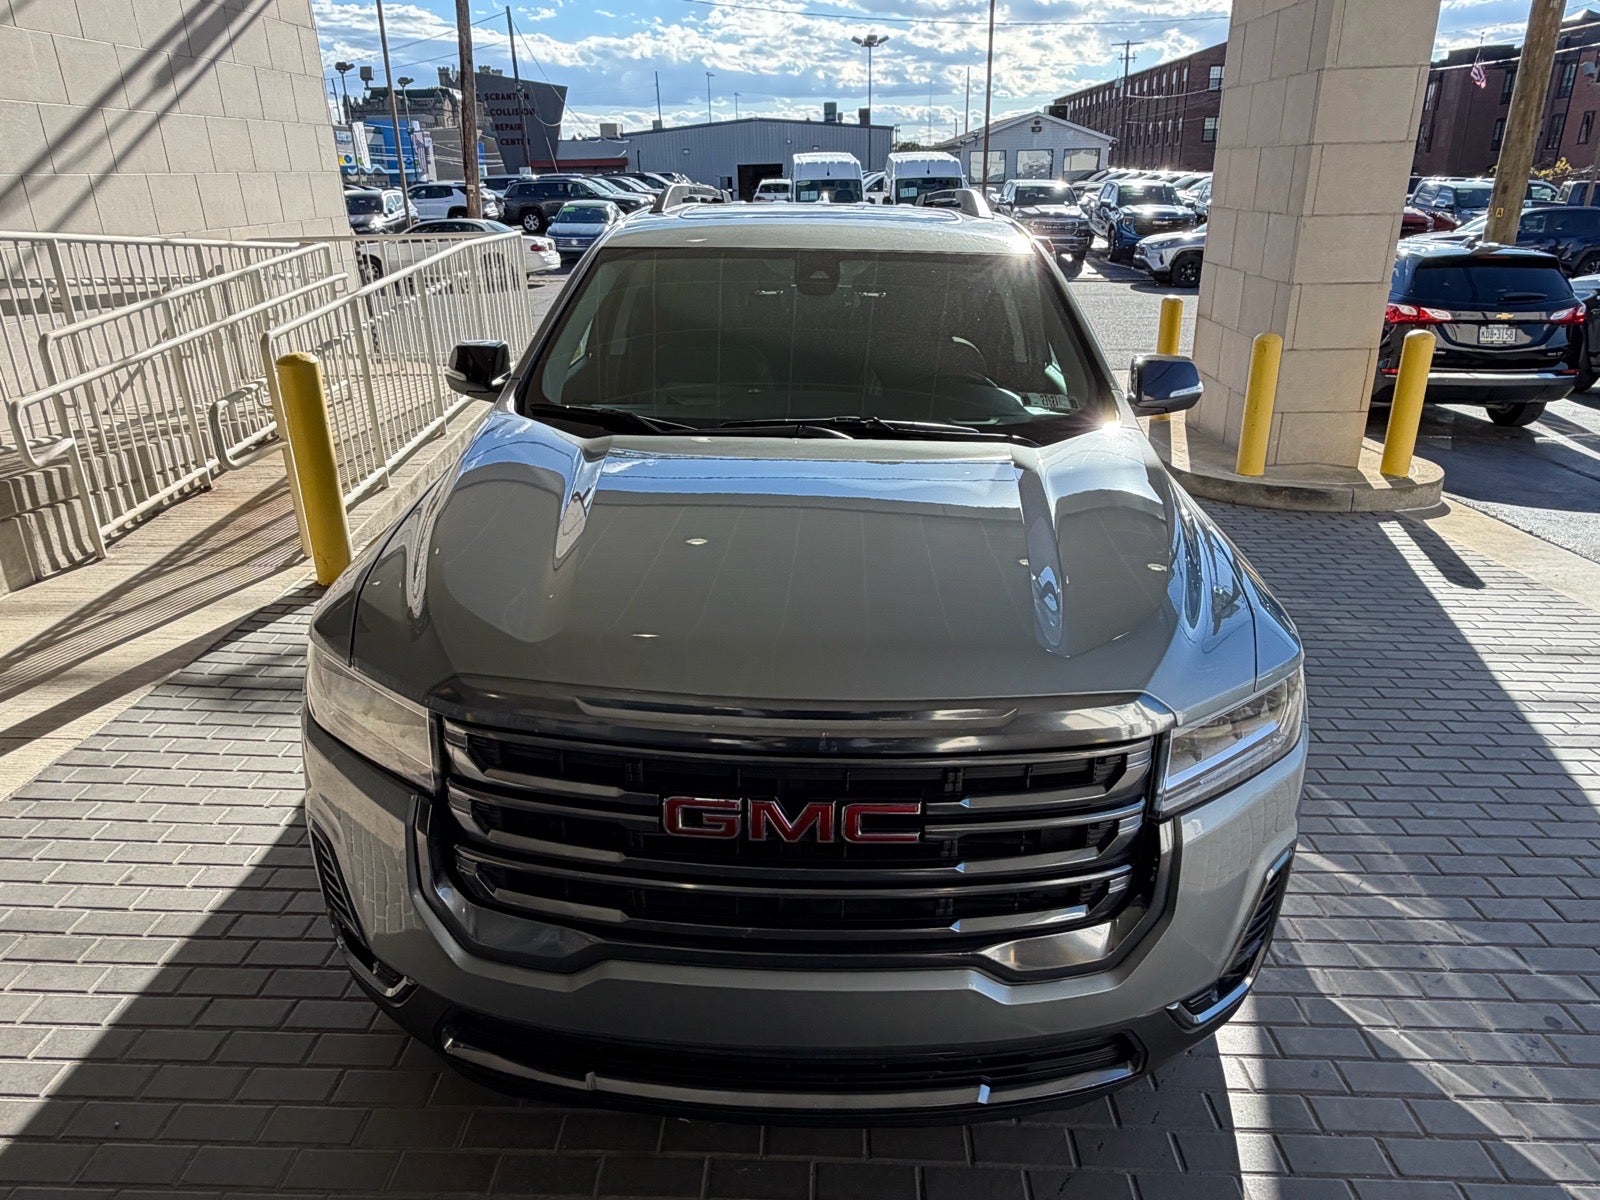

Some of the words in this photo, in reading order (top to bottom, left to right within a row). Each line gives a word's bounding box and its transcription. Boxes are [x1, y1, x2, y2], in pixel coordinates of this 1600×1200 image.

[484, 92, 530, 100] SCRANTN
[490, 108, 536, 116] COLLISON
[663, 795, 922, 844] GMC
